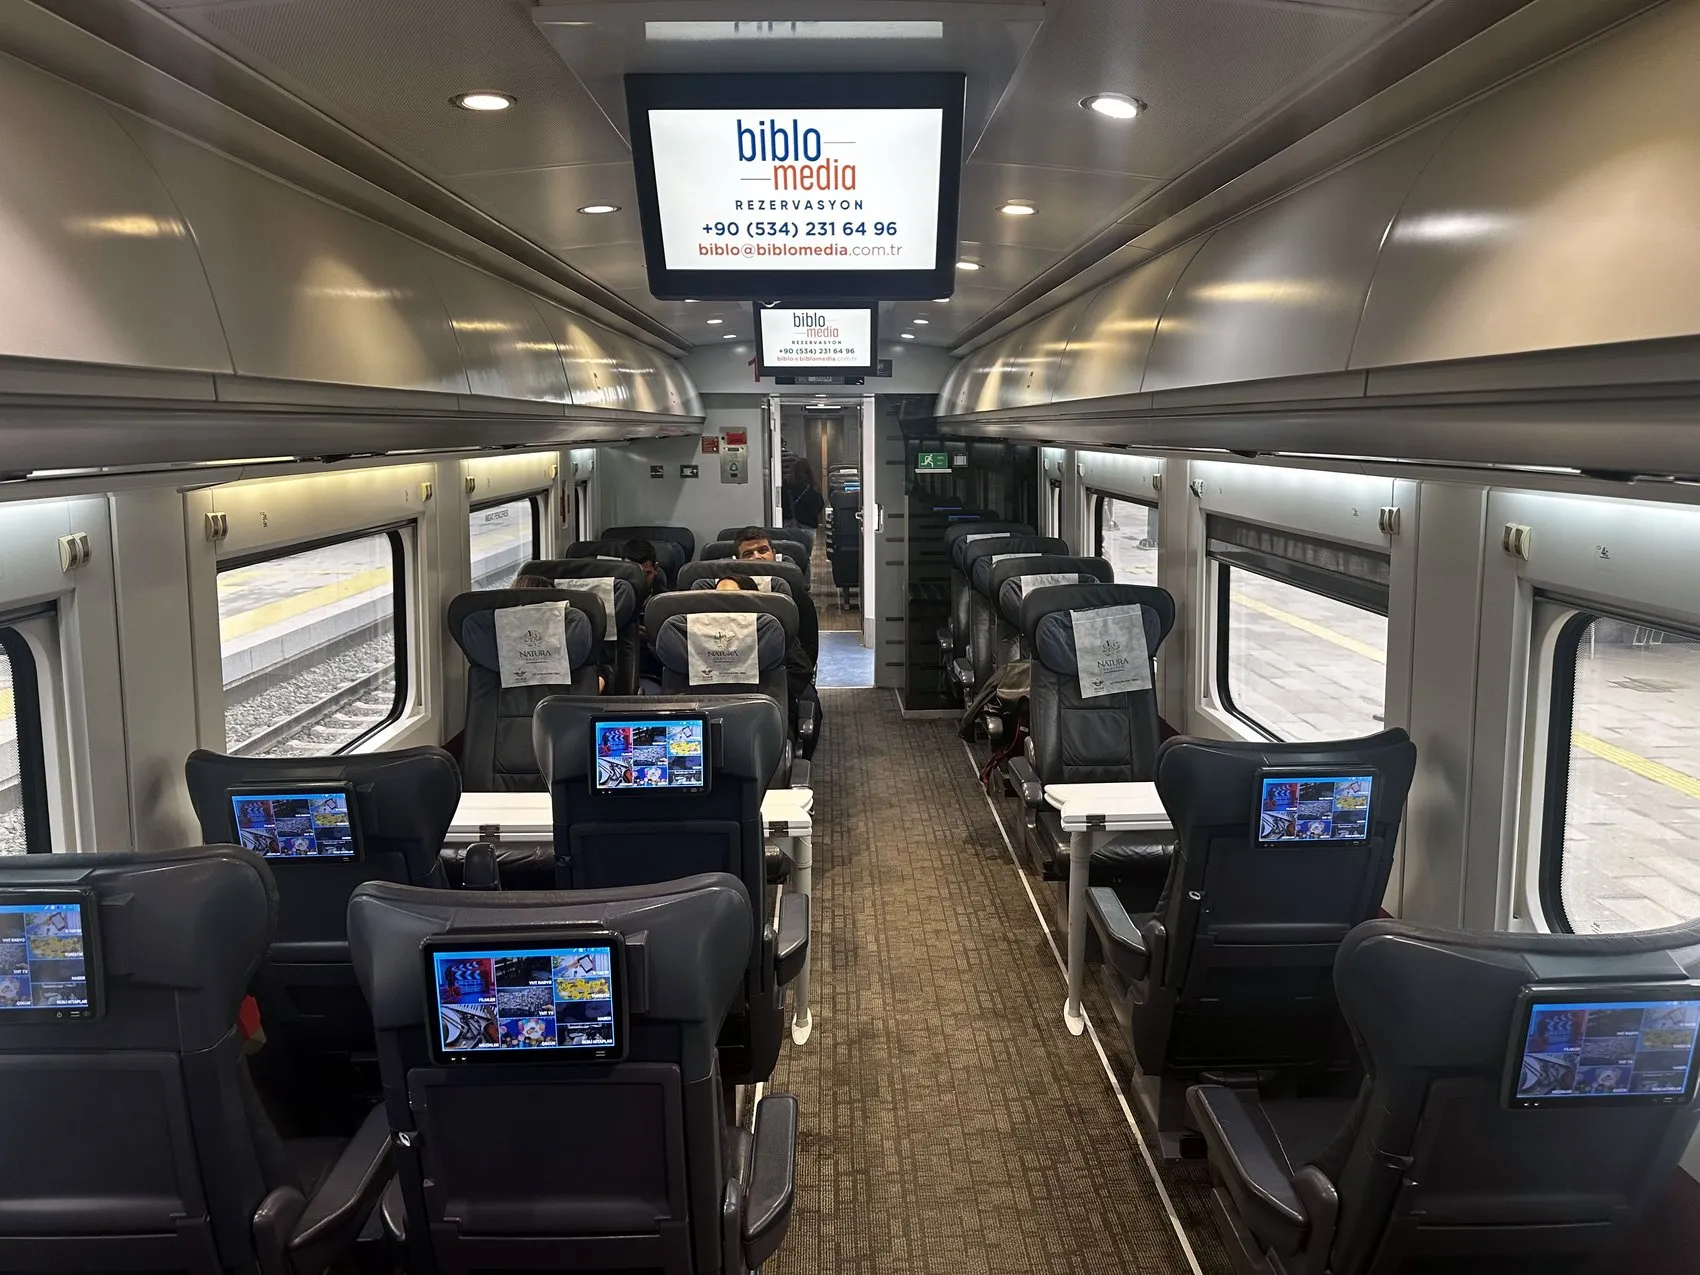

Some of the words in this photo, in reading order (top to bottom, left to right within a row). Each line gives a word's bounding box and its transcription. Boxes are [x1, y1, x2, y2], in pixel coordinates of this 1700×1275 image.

[736, 118, 822, 162] biblo
[773, 158, 857, 191] media
[735, 199, 864, 211] REZERVASYON
[702, 221, 740, 236] +90
[746, 221, 799, 239] (534)
[805, 221, 836, 236] 231
[843, 221, 867, 236] 64
[873, 221, 897, 236] 96
[698, 243, 903, 259] biblo@biblomedia.com.tr
[793, 312, 826, 328] biblo
[806, 325, 839, 338] media
[795, 347, 817, 355] (534)
[519, 649, 552, 658] NATURA
[1096, 657, 1129, 669] NATURA
